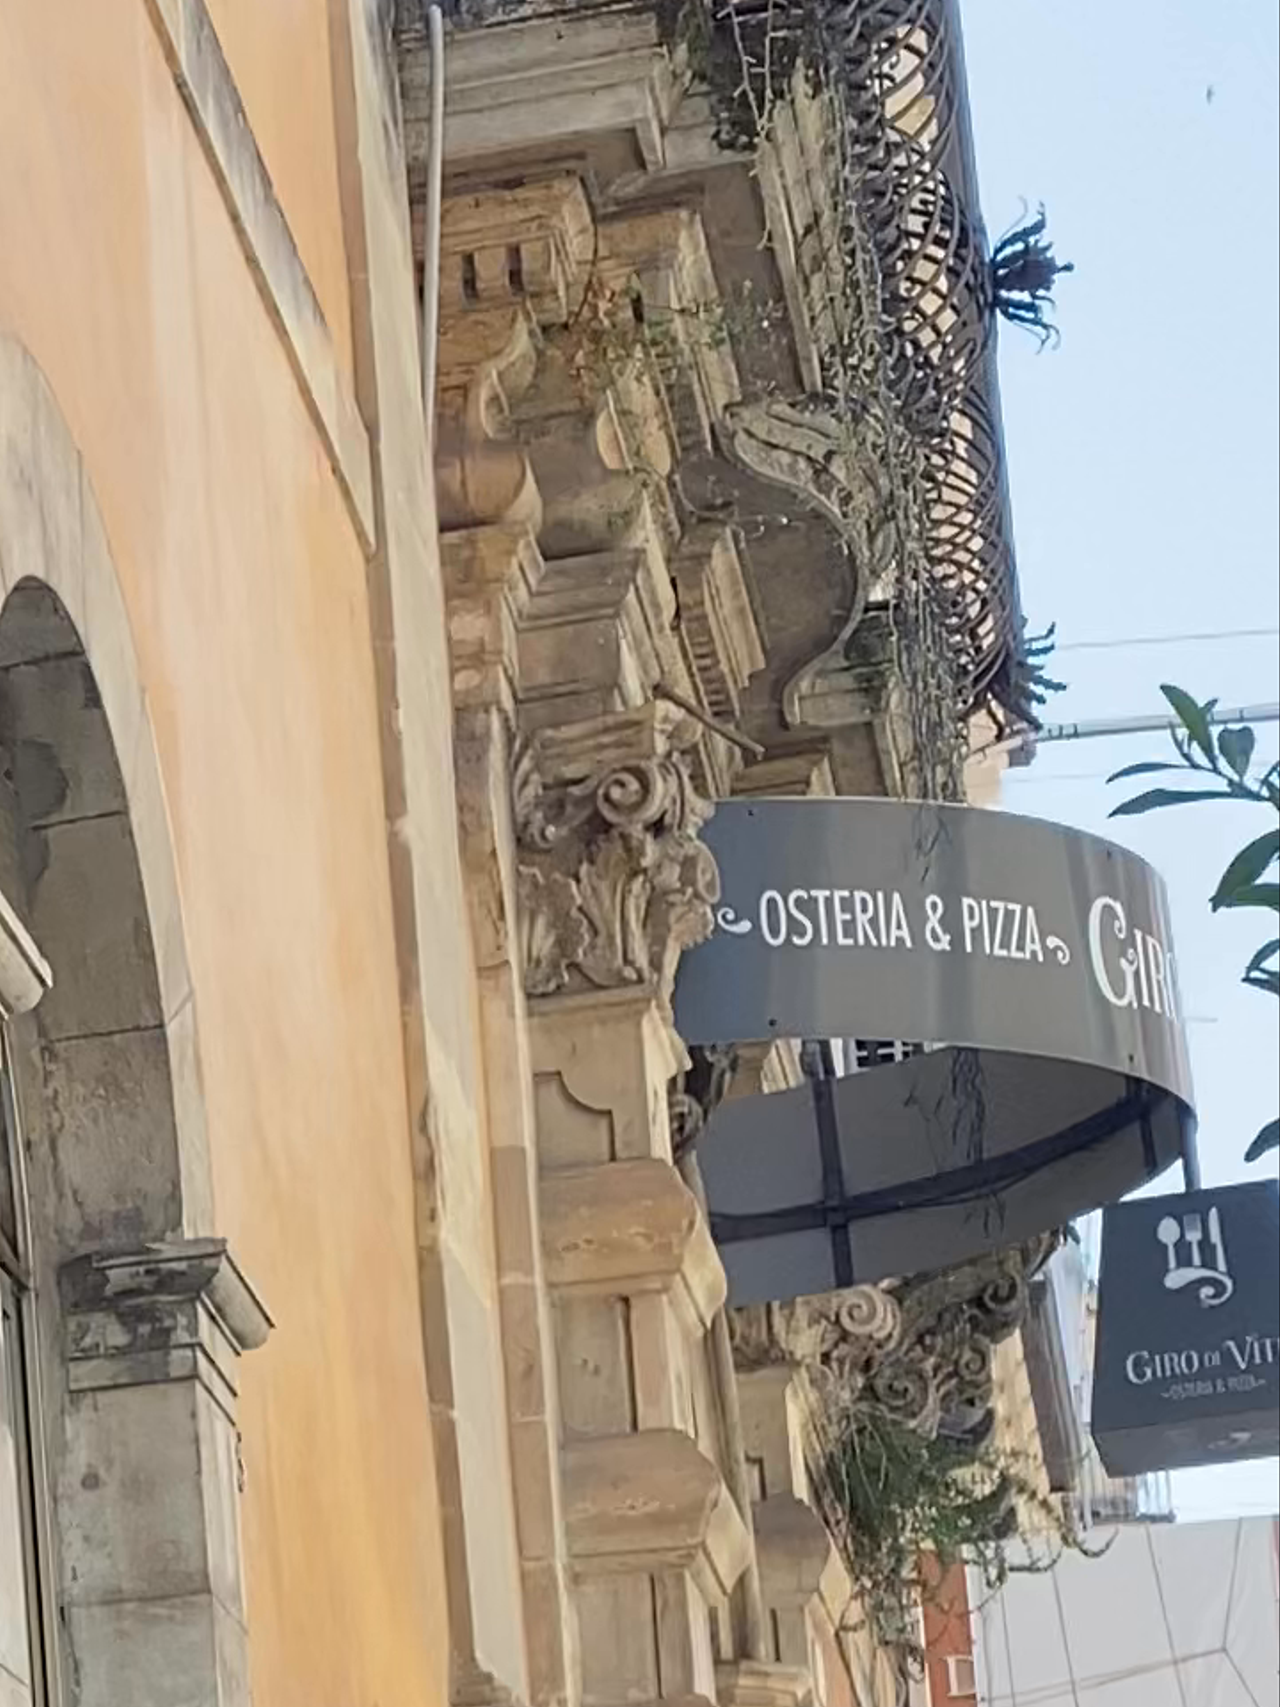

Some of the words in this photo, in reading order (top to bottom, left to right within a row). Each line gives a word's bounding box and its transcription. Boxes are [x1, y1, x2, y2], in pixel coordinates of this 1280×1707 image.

[758, 888, 913, 949] OSTERIA
[924, 893, 952, 952] &
[960, 895, 1045, 963] PIZZA
[1125, 1349, 1200, 1385] GIRO
[1222, 1334, 1280, 1370] VIT
